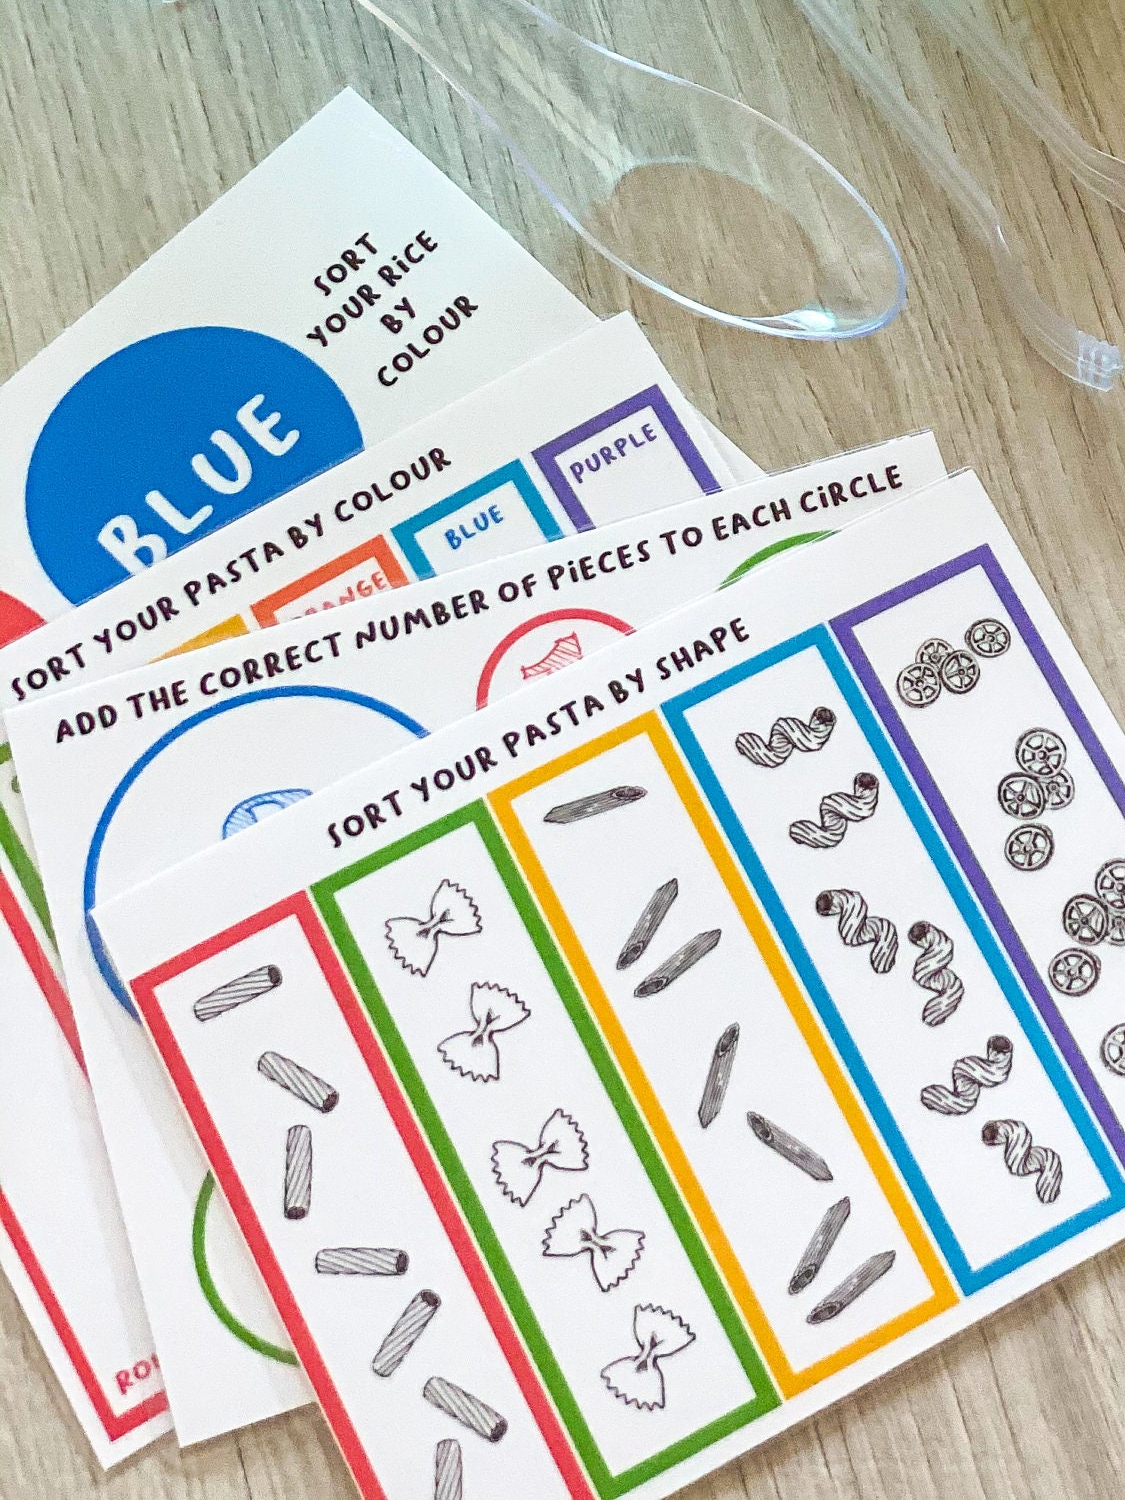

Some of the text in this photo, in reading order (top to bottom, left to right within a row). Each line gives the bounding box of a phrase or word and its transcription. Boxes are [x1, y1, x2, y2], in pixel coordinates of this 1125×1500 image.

[314, 233, 377, 296] SORT
[307, 284, 381, 347] YOUR
[378, 296, 478, 387] COLOUR
[380, 297, 416, 334] BY
[97, 394, 300, 576] BLUE
[569, 423, 658, 483] PURPLE
[444, 504, 504, 550] BLUE
[11, 447, 452, 701] SORT YOUR PASTA BY COLOUR
[56, 704, 117, 743] ADD
[126, 680, 189, 719] THE
[200, 632, 341, 695] CORRECT
[356, 588, 489, 649] NUMBER
[498, 574, 537, 605] OF
[660, 526, 702, 556] TO
[712, 498, 791, 541] EACH
[327, 617, 750, 848] SORT YOUR PASTA BY SHAPE
